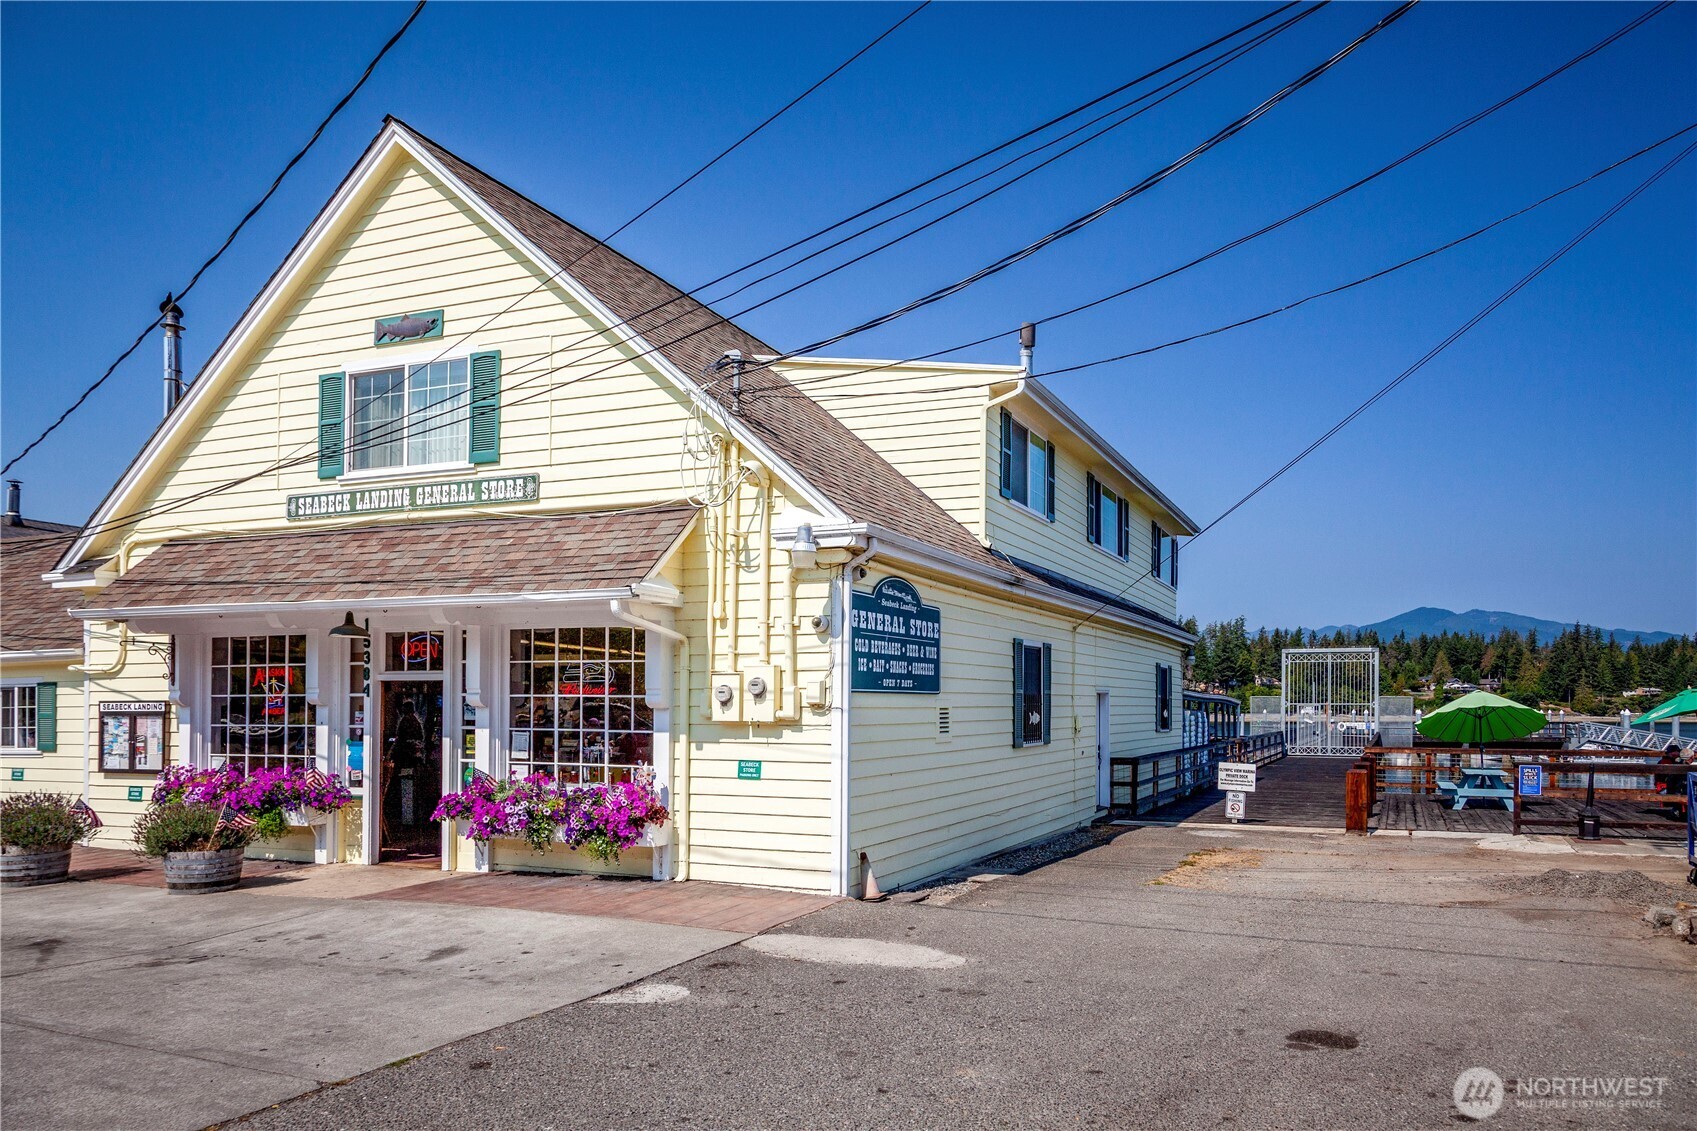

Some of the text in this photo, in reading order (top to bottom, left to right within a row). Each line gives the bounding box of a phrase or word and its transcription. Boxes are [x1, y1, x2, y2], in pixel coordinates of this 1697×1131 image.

[298, 478, 524, 515] SEABECK LANDING GENERAL STORE
[881, 598, 917, 614] Seabeck Landing
[851, 609, 940, 639] GENERAL STORE
[400, 641, 439, 659] OPEN
[854, 638, 937, 659] COLD BEVERAGES BEER & WINE
[858, 658, 935, 676] ICE BAIT SNACKS GROCERIES
[559, 683, 617, 695] Budweisr
[883, 678, 895, 687] OPEN
[133, 703, 163, 711] LANDING
